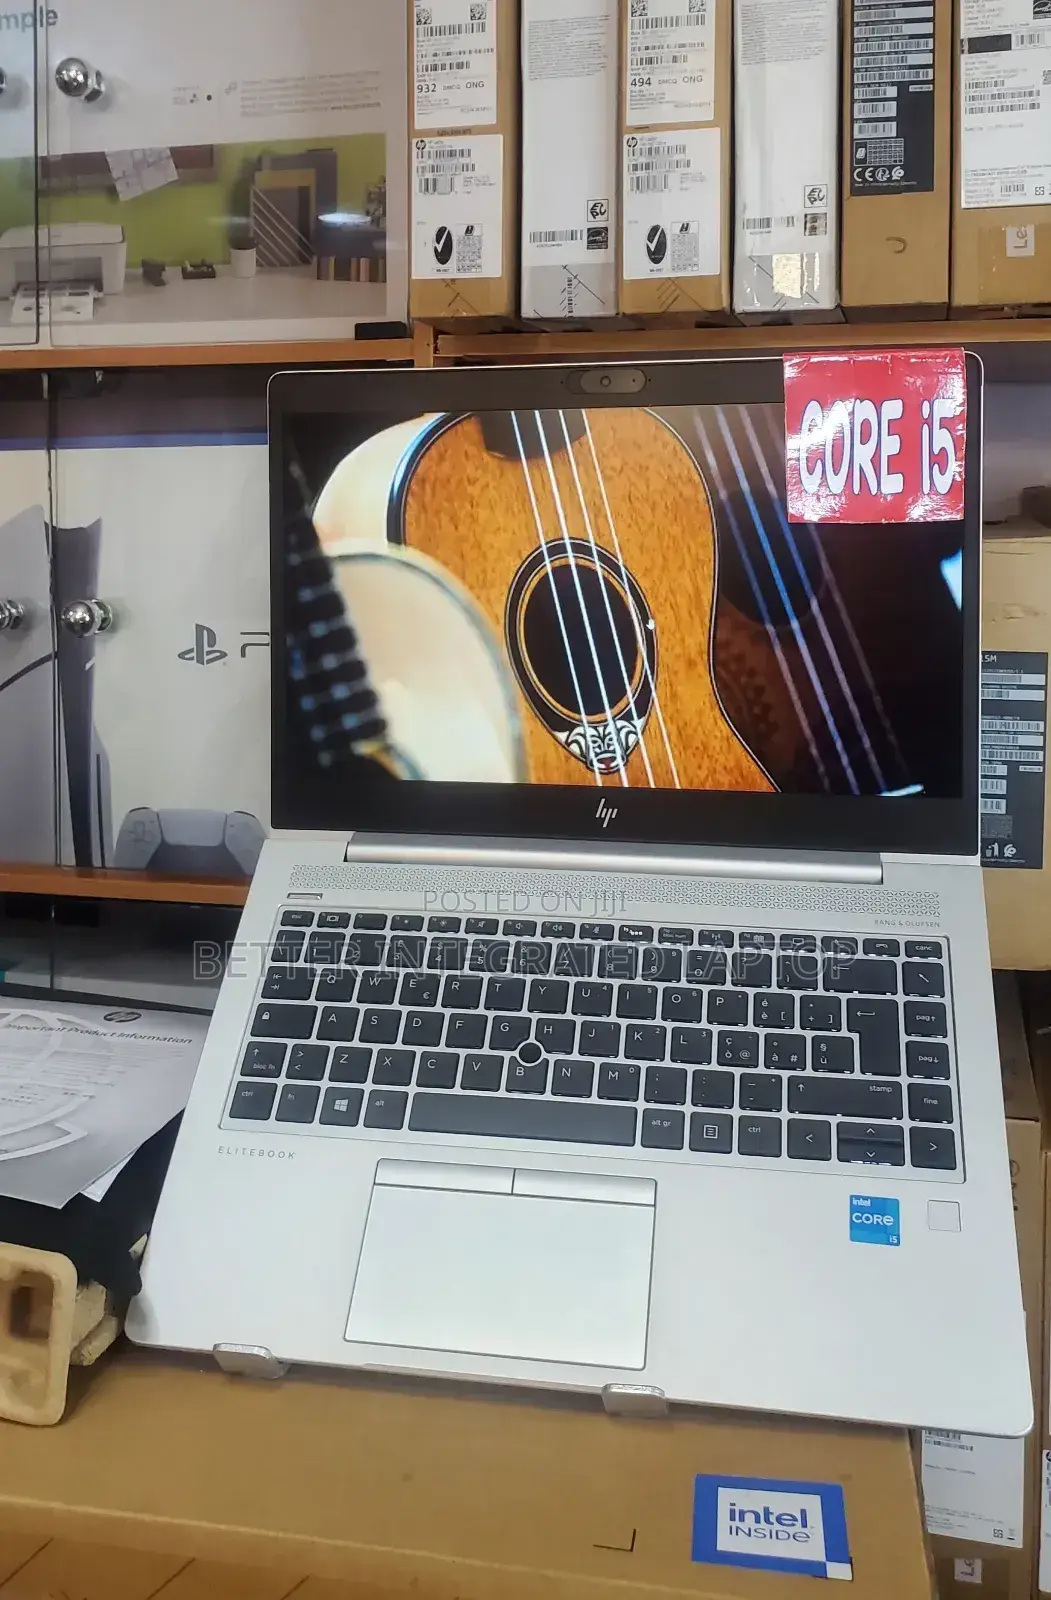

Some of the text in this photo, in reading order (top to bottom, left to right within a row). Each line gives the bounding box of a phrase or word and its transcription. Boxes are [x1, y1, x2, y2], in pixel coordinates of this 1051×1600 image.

[630, 77, 652, 87] 494
[682, 75, 703, 84] ONG
[416, 83, 437, 93] 932
[465, 80, 485, 88] ONG
[800, 398, 956, 496] CORE i5
[595, 798, 618, 828] hp
[326, 975, 336, 984] Q
[369, 977, 382, 986] W
[410, 979, 417, 988] E
[452, 982, 460, 990] R
[494, 984, 502, 992] T
[538, 986, 547, 994] Y
[582, 988, 591, 998] U
[671, 994, 682, 1004] O
[716, 997, 724, 1006] P
[328, 1014, 337, 1022] A
[370, 1016, 378, 1024] S
[412, 1018, 422, 1027] D
[916, 1014, 930, 1022] pag
[456, 1020, 464, 1030] F
[500, 1022, 510, 1032] G
[544, 1026, 552, 1034] H
[68, 1027, 116, 1038] Product
[118, 1032, 193, 1044] Information
[588, 1028, 596, 1038] J
[634, 1031, 643, 1041] K
[680, 1034, 688, 1044] L
[340, 1054, 349, 1064] Z
[740, 1050, 750, 1060] @
[918, 1055, 932, 1063] pag
[383, 1056, 392, 1066] X
[428, 1060, 436, 1068] C
[472, 1062, 482, 1071] V
[516, 1066, 524, 1076] B
[562, 1068, 571, 1078] N
[608, 1071, 618, 1080] M
[869, 1084, 892, 1093] stamp
[218, 1146, 296, 1160] ELITEBOOK
[852, 1197, 871, 1207] intel
[889, 1235, 898, 1244] i5
[729, 1502, 808, 1528] intel
